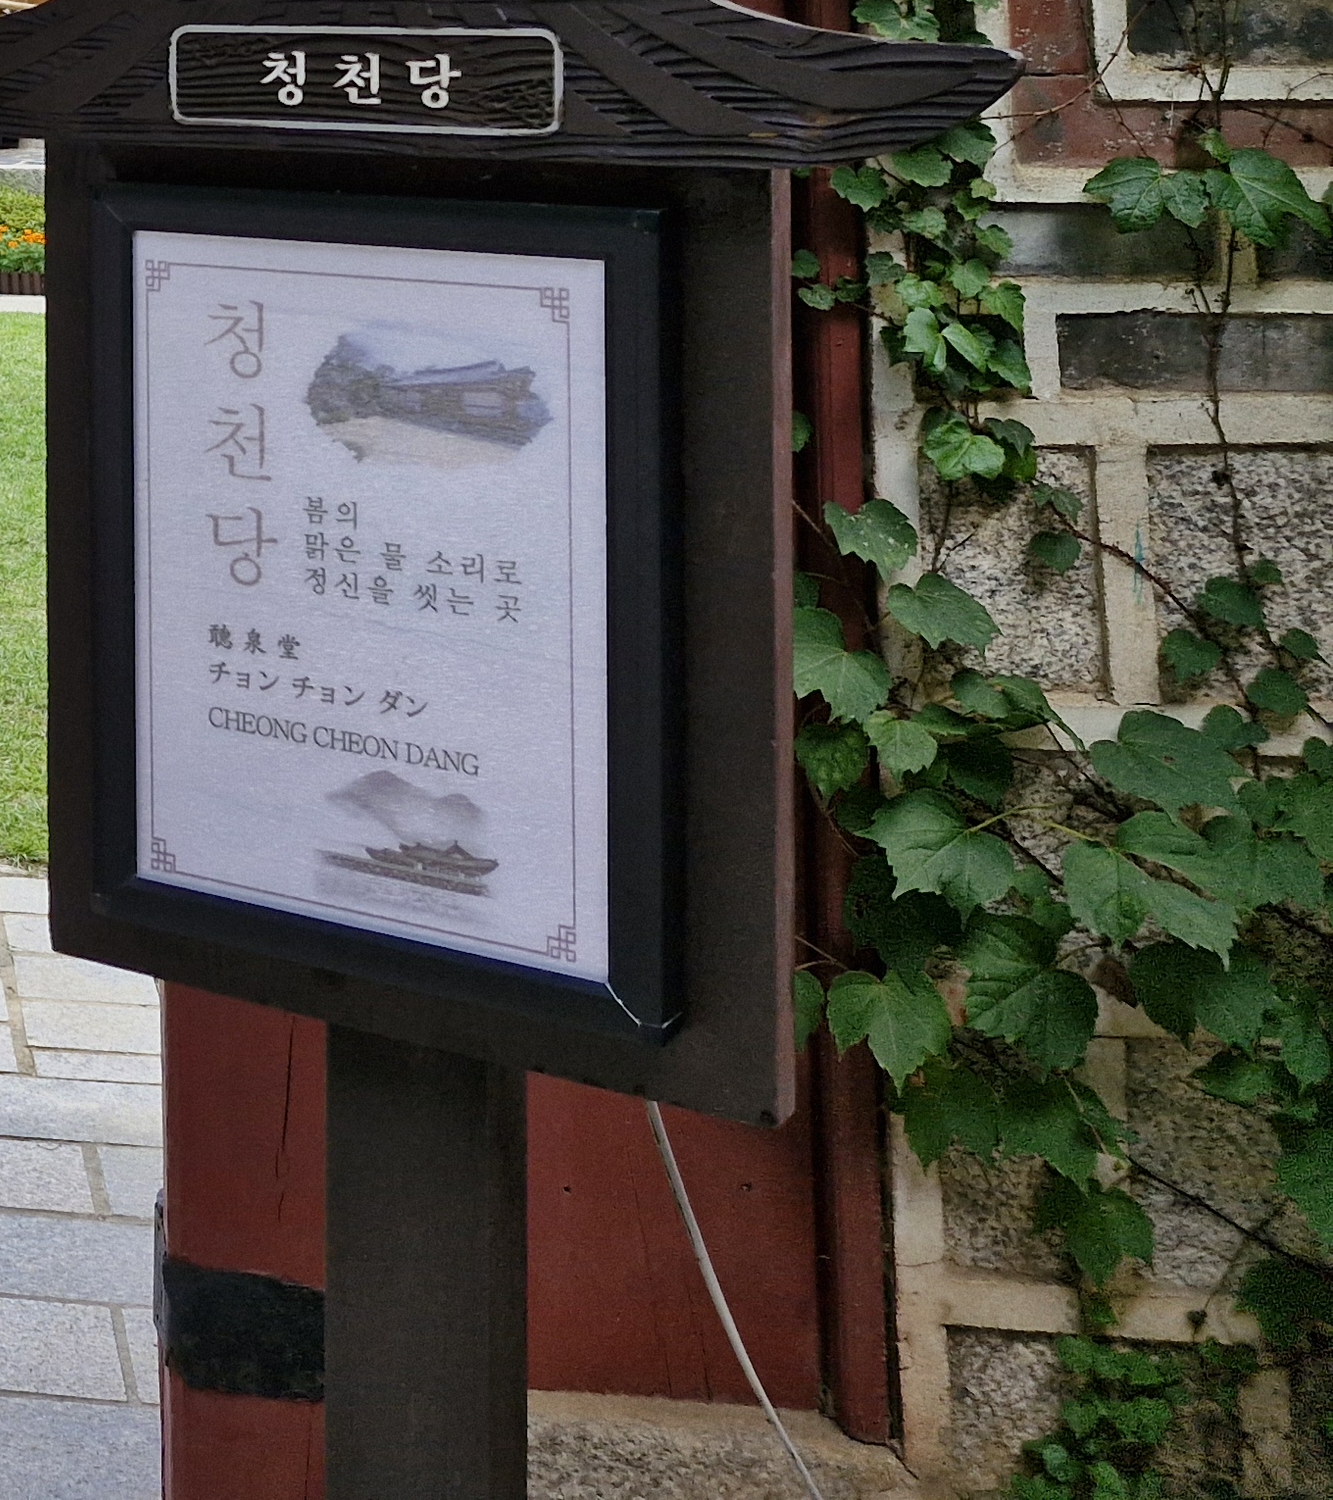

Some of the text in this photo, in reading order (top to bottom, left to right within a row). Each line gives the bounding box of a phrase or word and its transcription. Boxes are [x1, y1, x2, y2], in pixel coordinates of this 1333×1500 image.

[259, 50, 463, 109] 청천당
[203, 299, 279, 586] 청천당
[302, 496, 358, 531] 봄의
[304, 532, 523, 585] 맑은 물 소리로
[304, 567, 522, 623] 정신을 씻는 곳
[207, 706, 480, 777] CHEONG CHEON DANG
